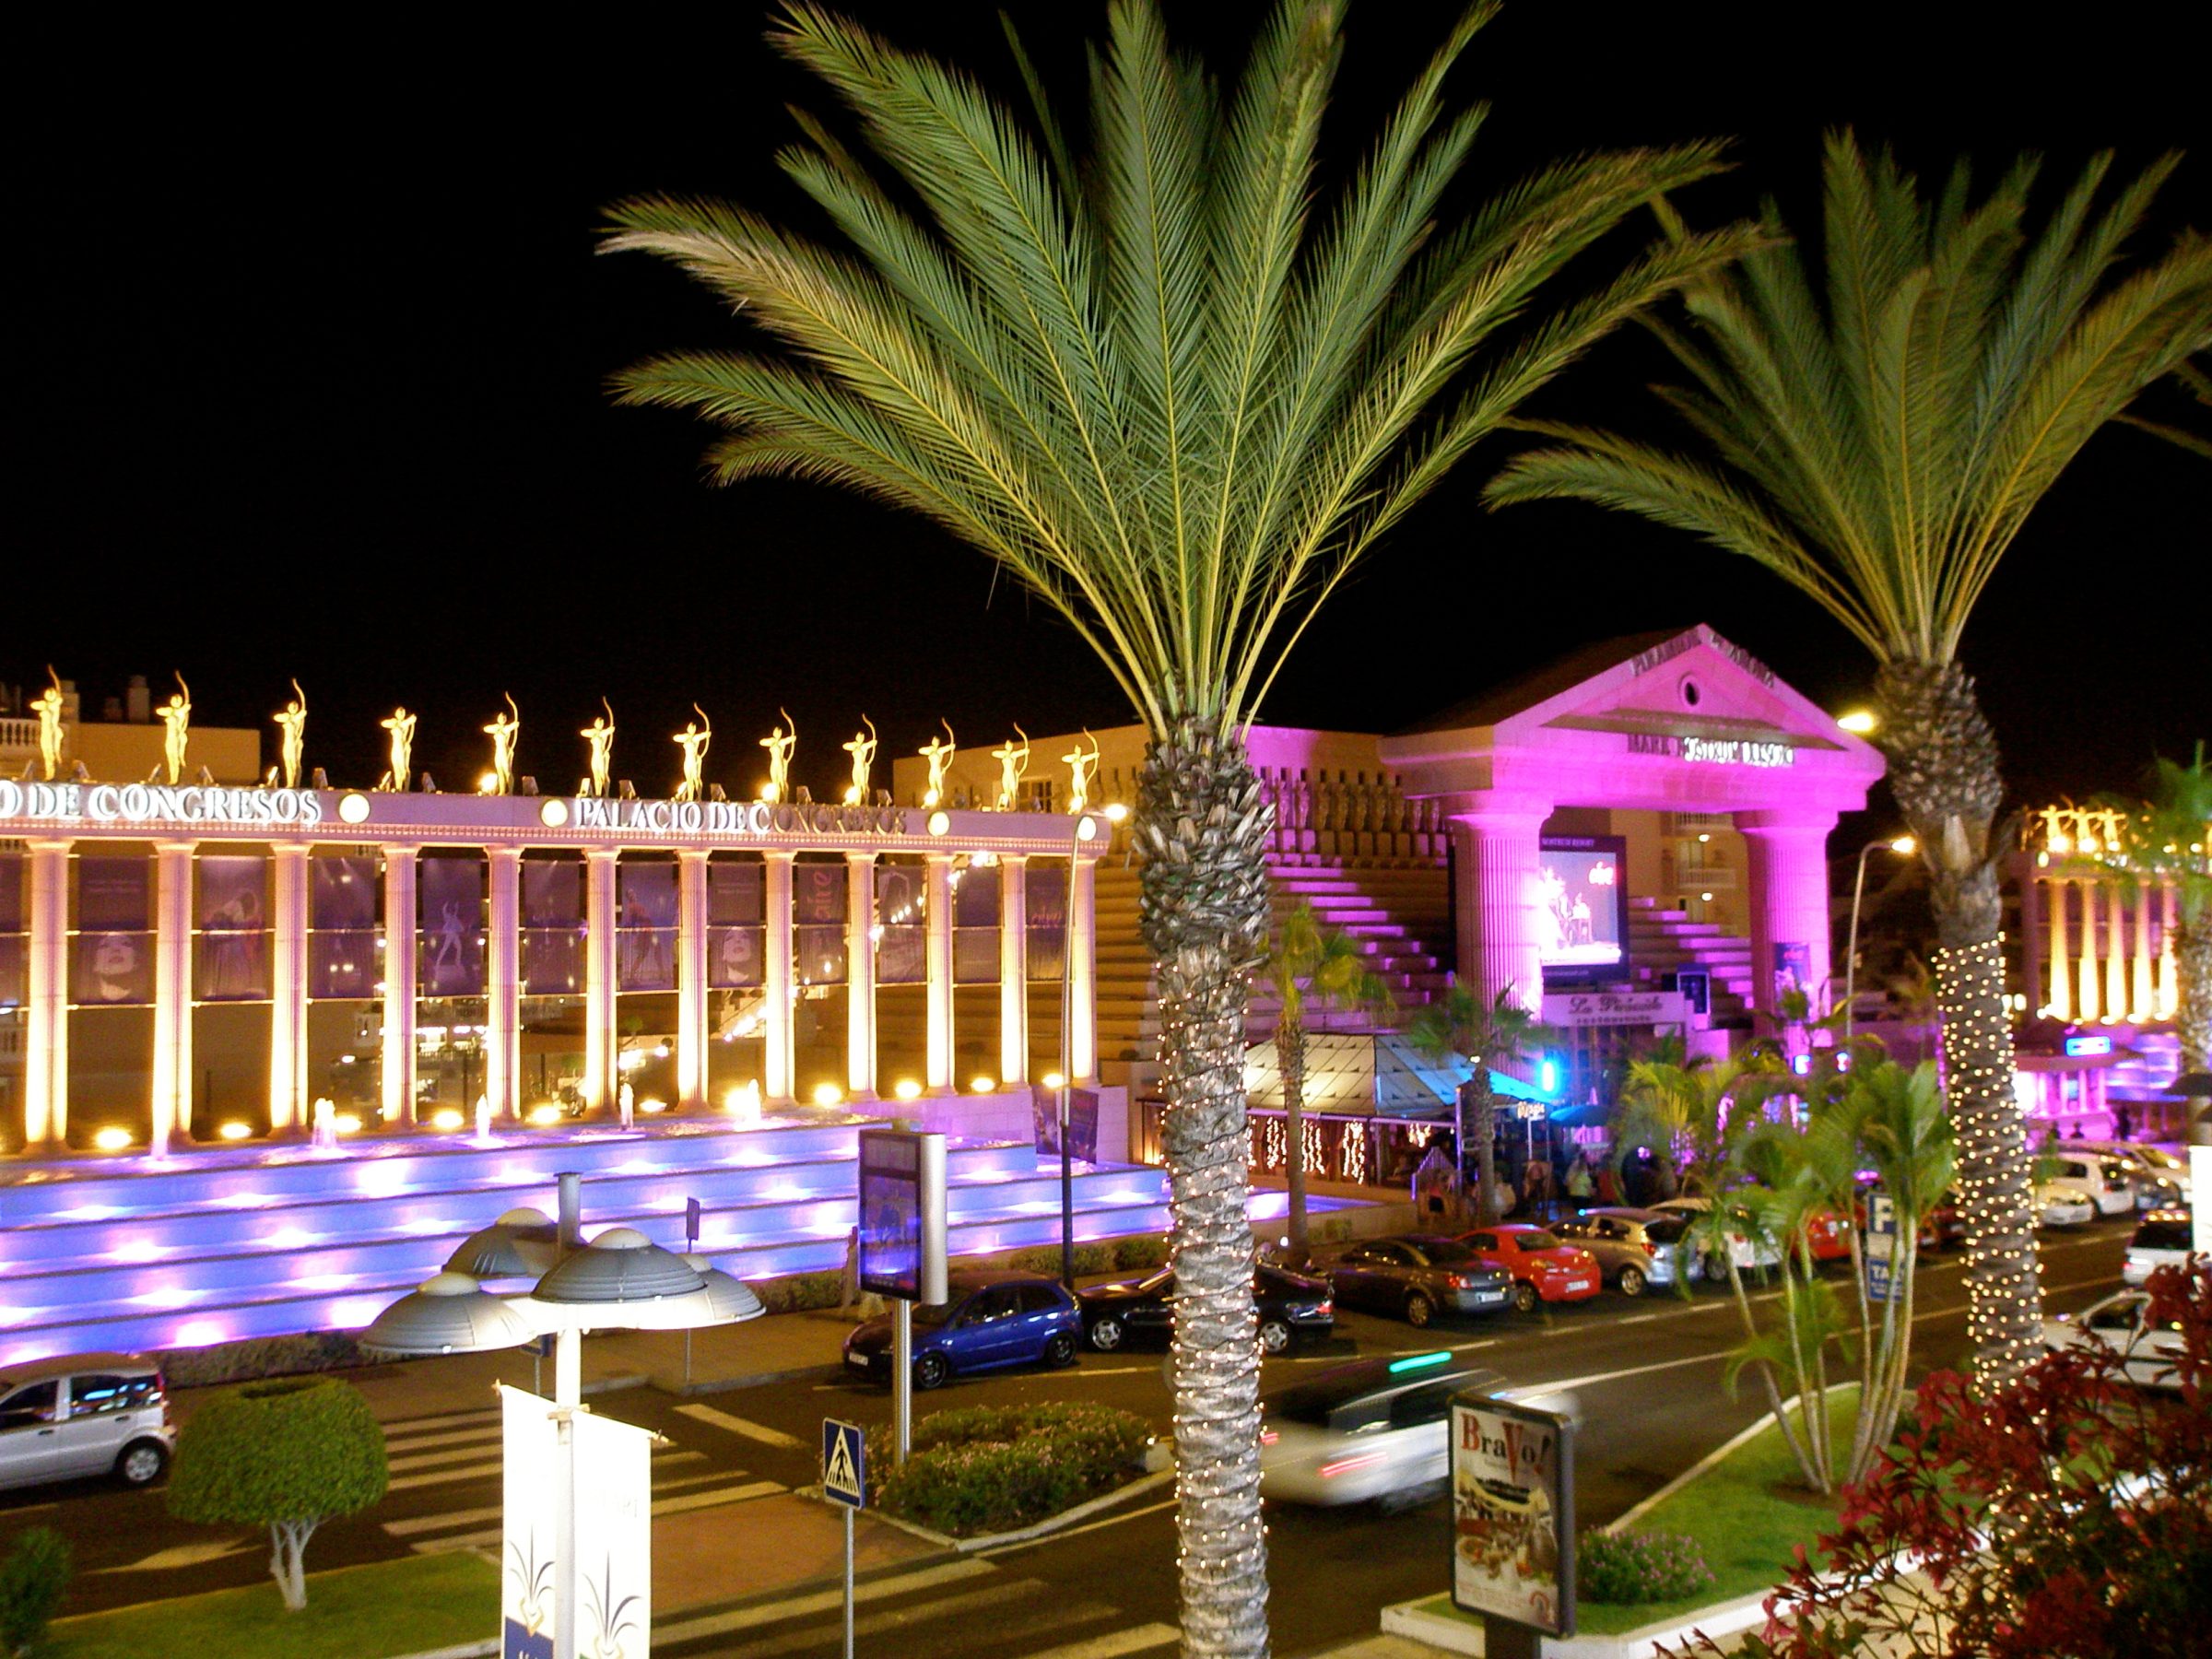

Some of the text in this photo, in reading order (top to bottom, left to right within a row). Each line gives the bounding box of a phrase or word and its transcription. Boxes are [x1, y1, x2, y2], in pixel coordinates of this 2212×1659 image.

[29, 782, 81, 821] DE
[88, 783, 323, 826] CONGRESOS
[575, 798, 702, 833] PALACIO
[709, 801, 745, 834] DE
